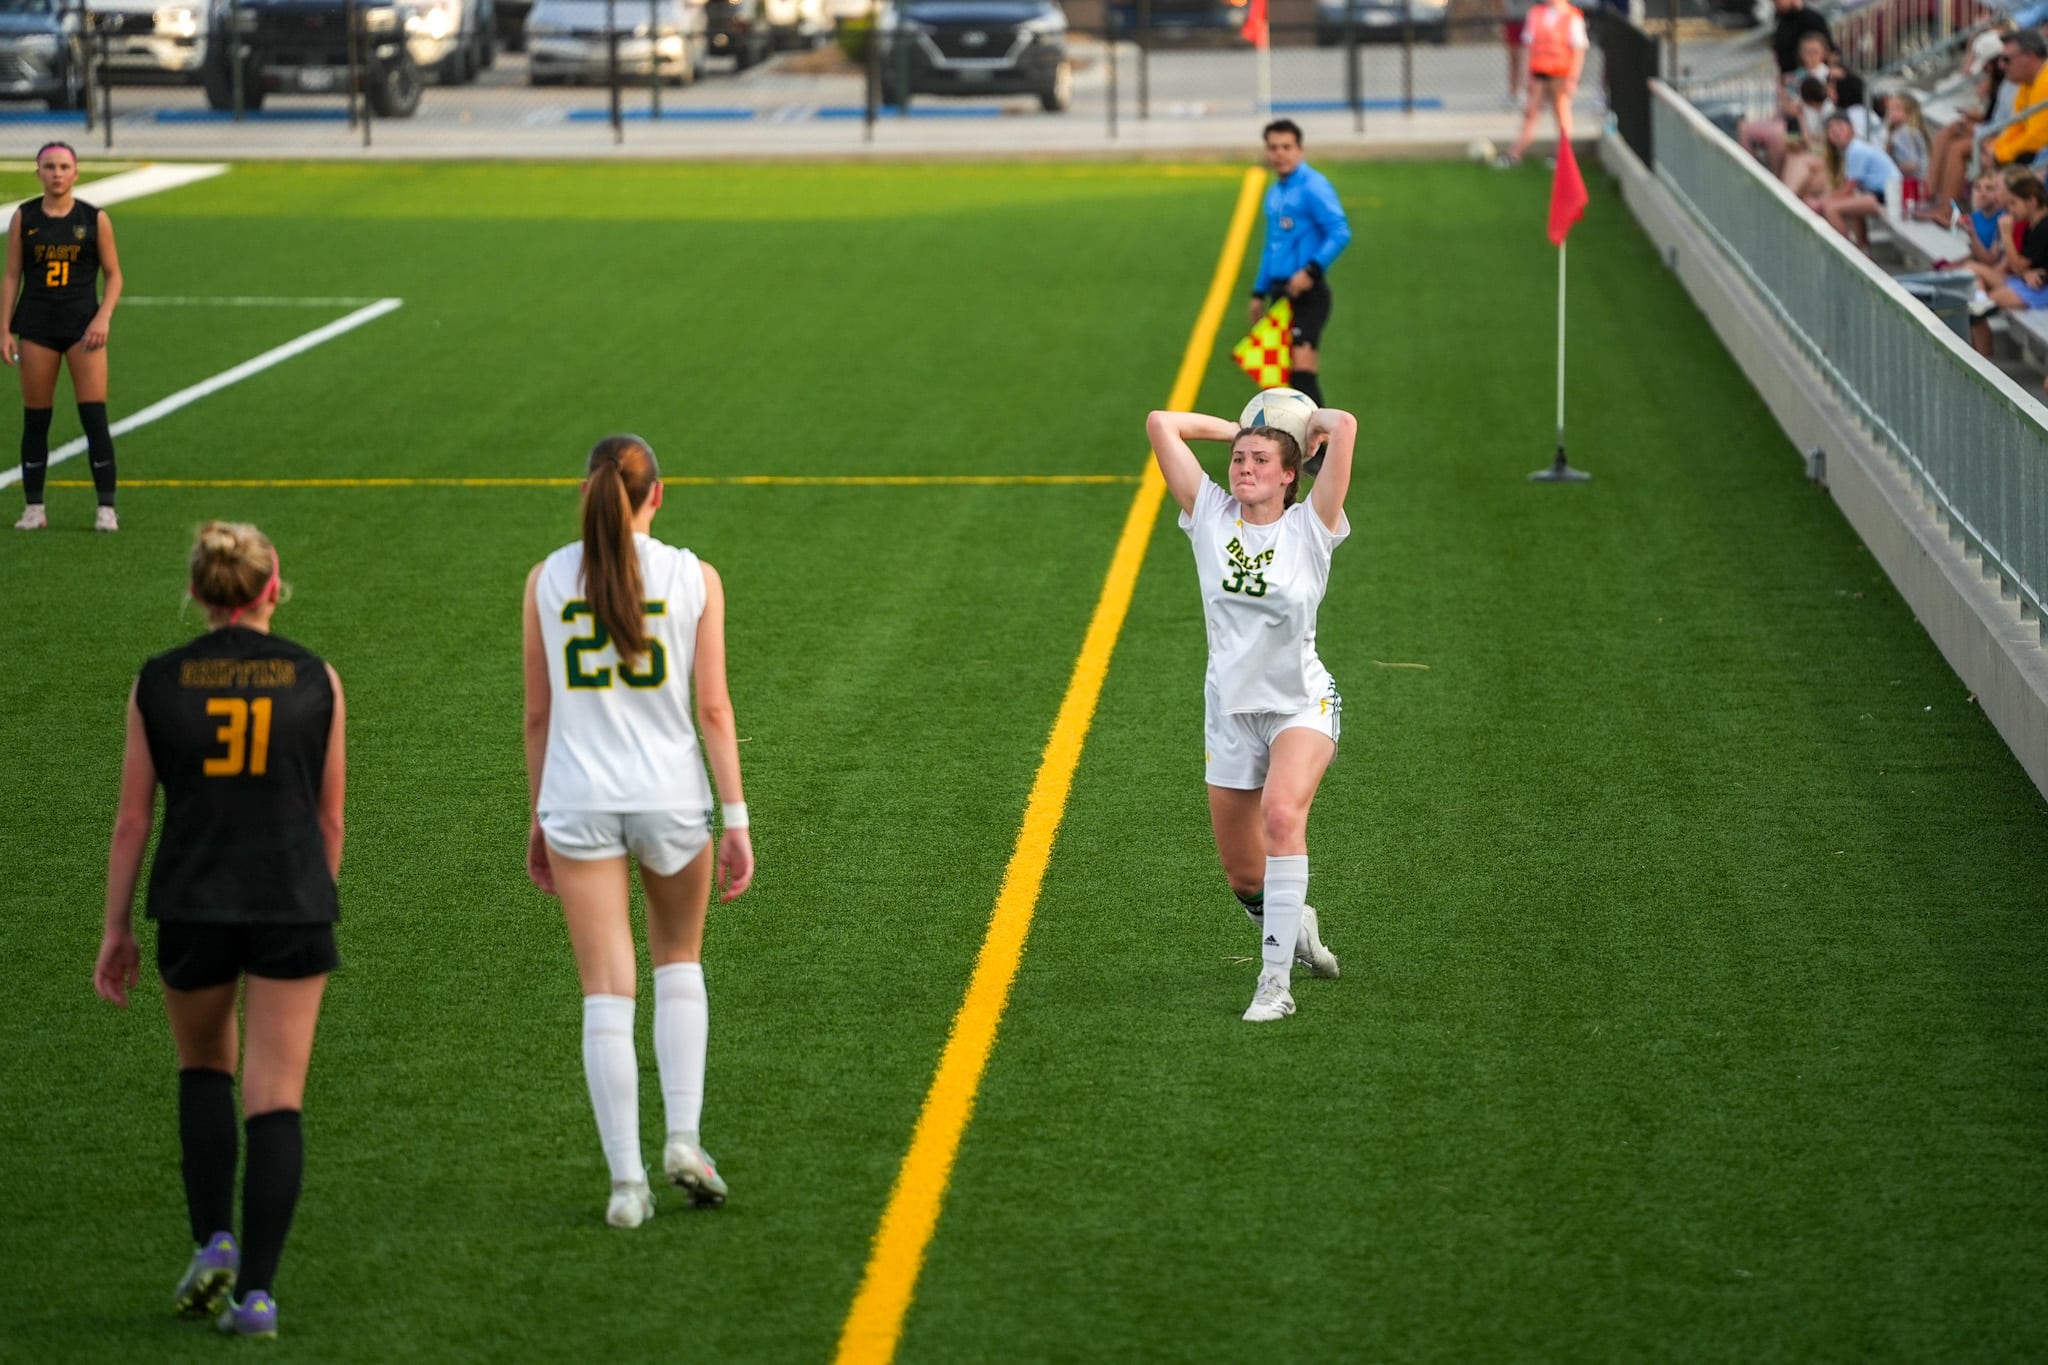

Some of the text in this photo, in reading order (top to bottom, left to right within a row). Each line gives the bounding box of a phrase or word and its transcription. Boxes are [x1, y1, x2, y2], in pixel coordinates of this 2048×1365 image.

[46, 260, 70, 287] 21
[1222, 557, 1268, 598] 33
[561, 598, 668, 690] 25
[203, 697, 273, 777] 31
